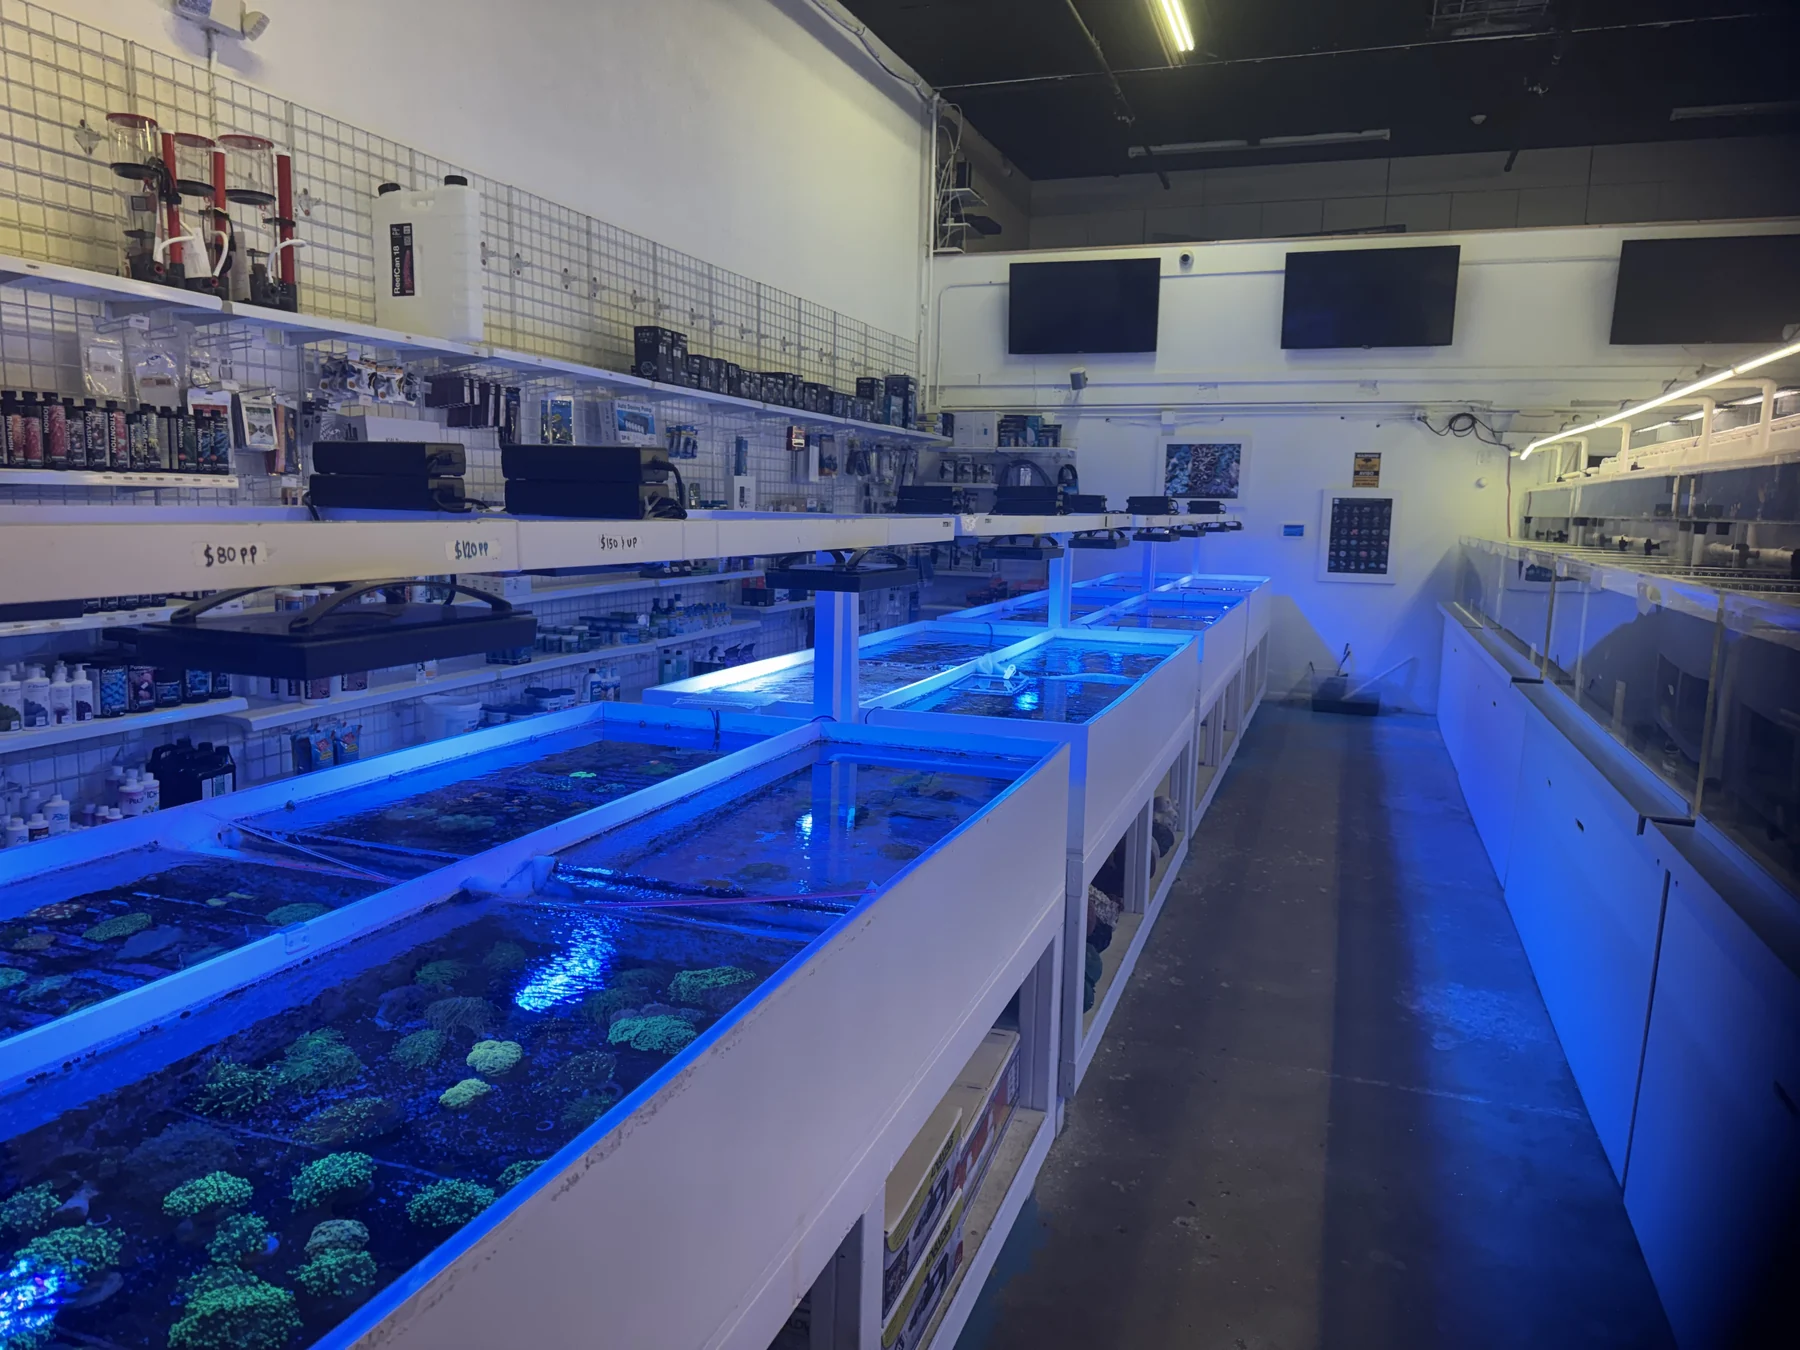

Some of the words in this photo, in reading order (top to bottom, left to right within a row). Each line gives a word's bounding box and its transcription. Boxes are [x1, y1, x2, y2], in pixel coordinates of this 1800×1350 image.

[393, 245, 400, 255] 18
[455, 540, 477, 560] $120
[600, 534, 618, 550] $150
[626, 537, 637, 548] UP
[204, 544, 236, 567] $80
